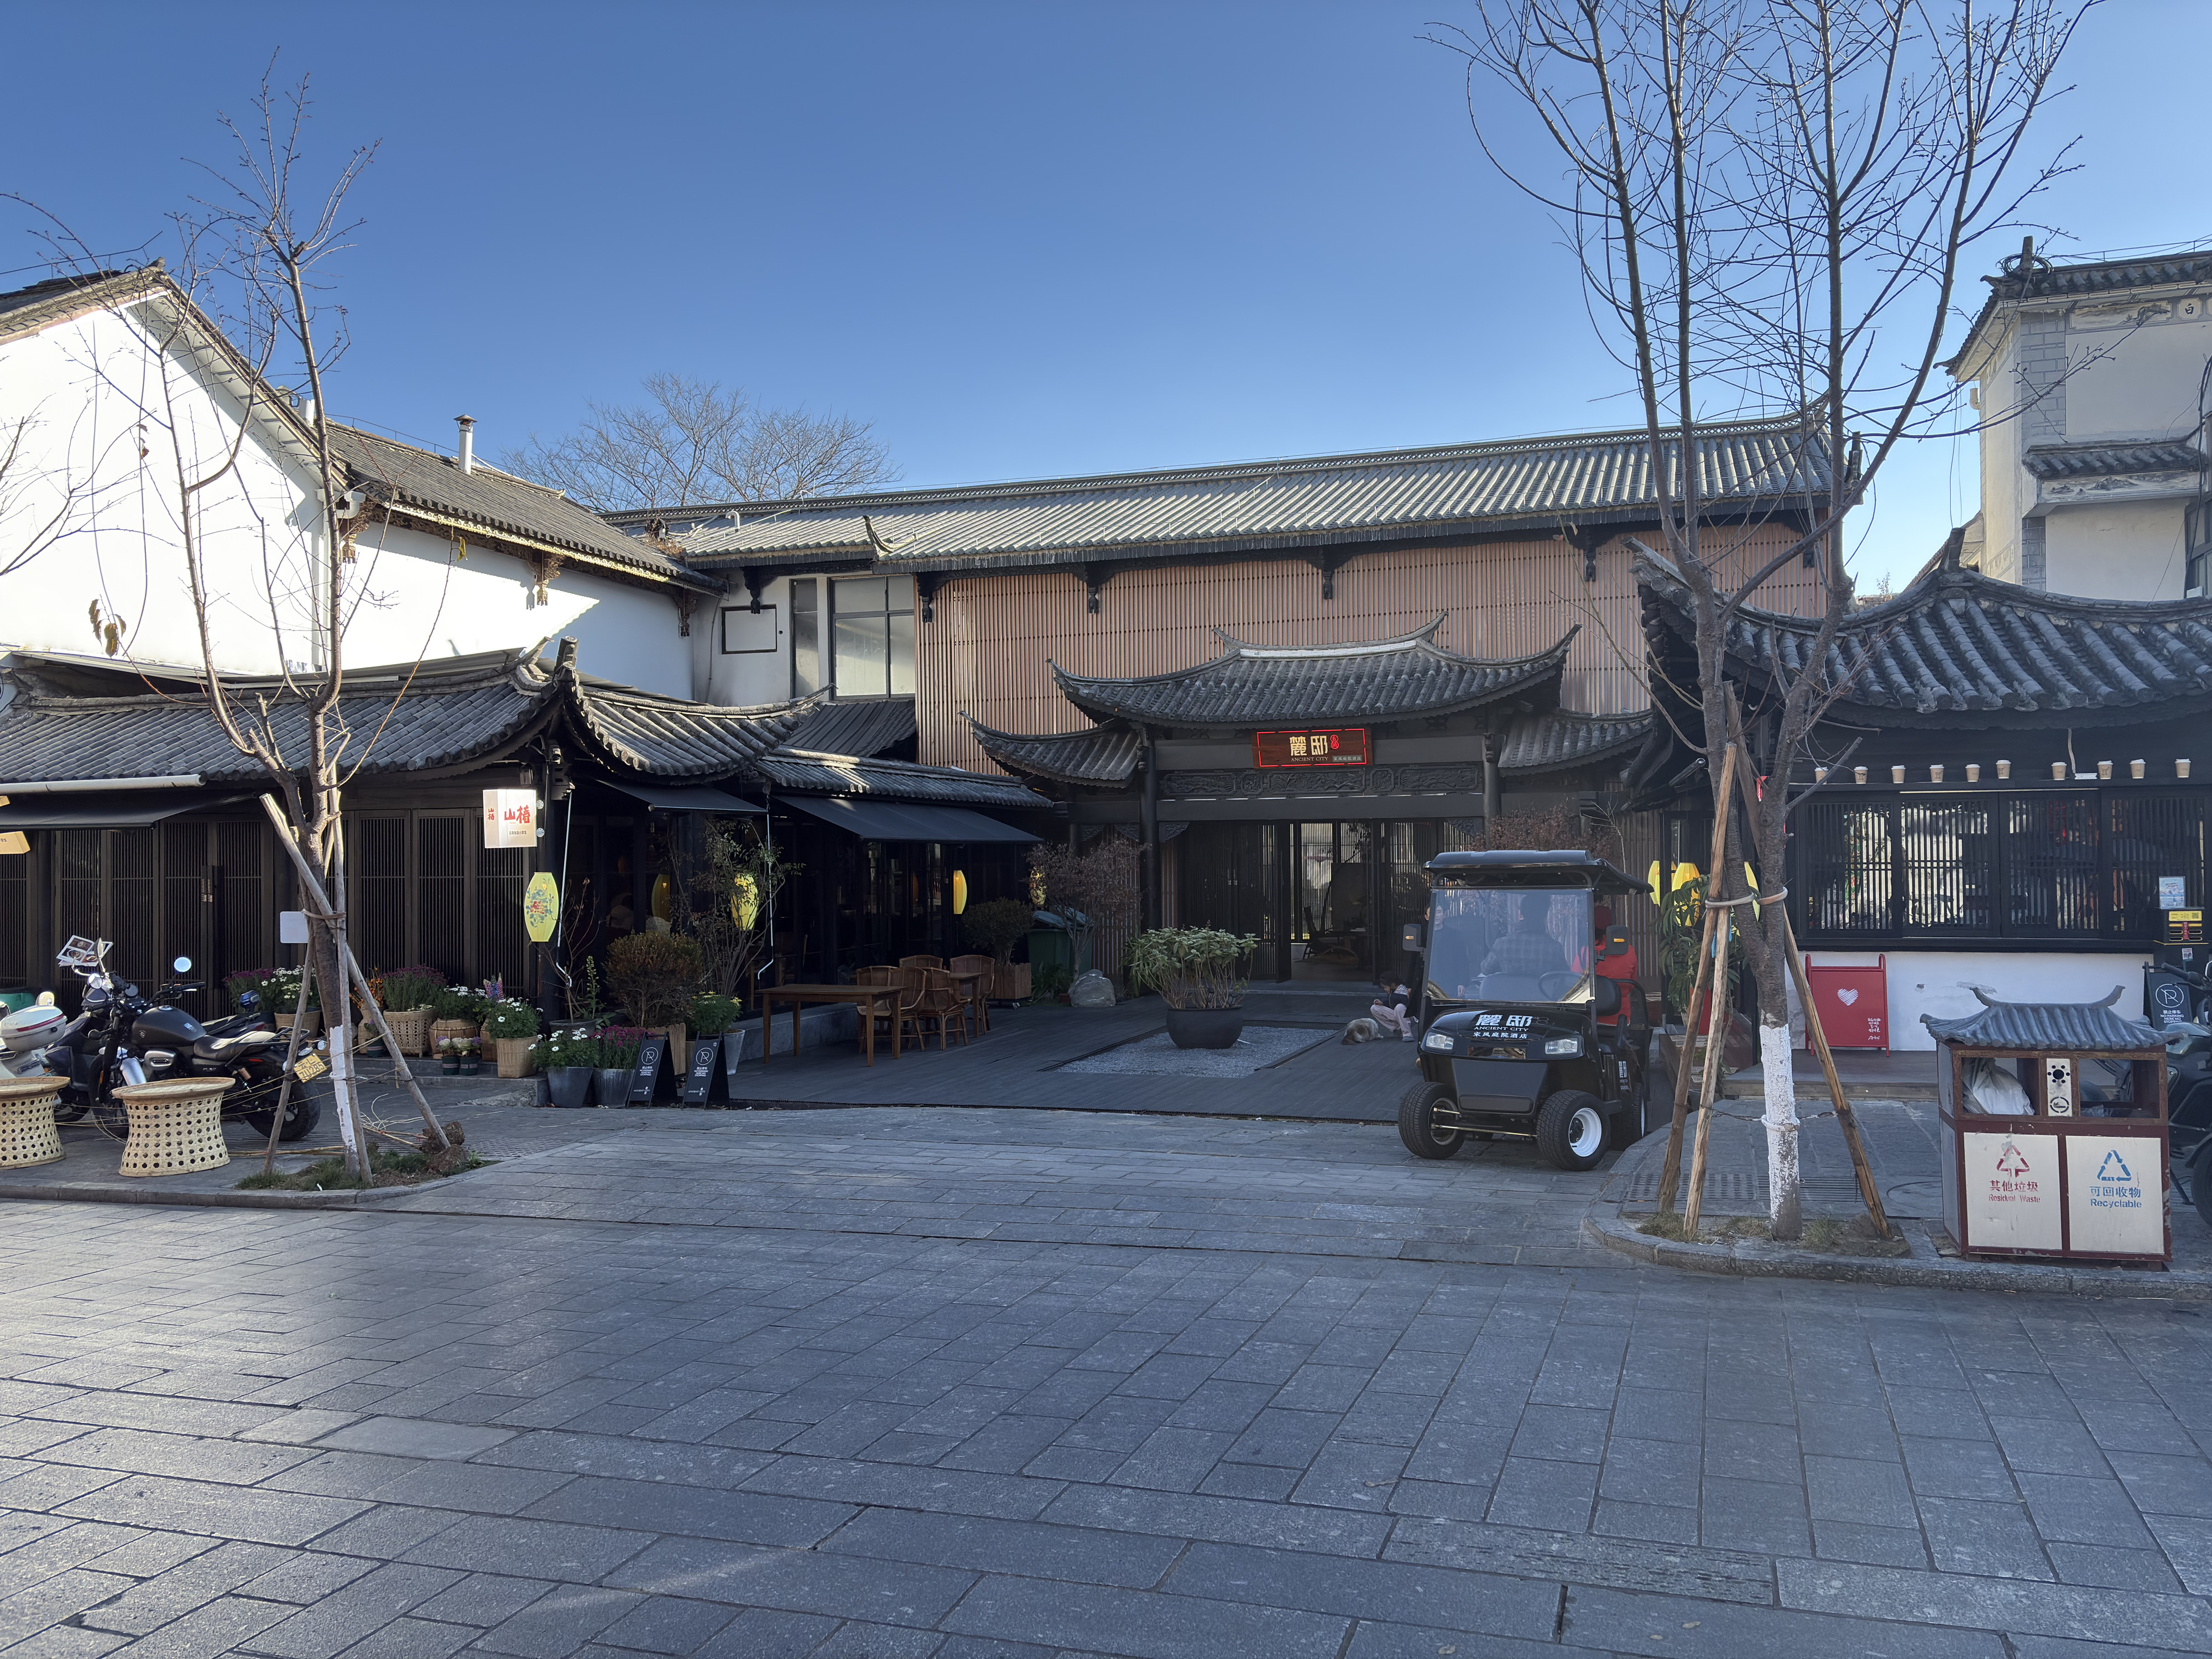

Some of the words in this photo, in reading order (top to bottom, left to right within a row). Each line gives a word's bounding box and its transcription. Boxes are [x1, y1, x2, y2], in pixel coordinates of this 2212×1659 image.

[2185, 302, 2194, 315] 白
[487, 807, 495, 821] 山椿
[504, 805, 530, 824] 山椿
[1989, 1180, 2038, 1192] 其他垃圾
[2090, 1186, 2141, 1198] 可回收物
[2020, 1194, 2041, 1203] Waste
[2090, 1198, 2142, 1208] Recyclable
